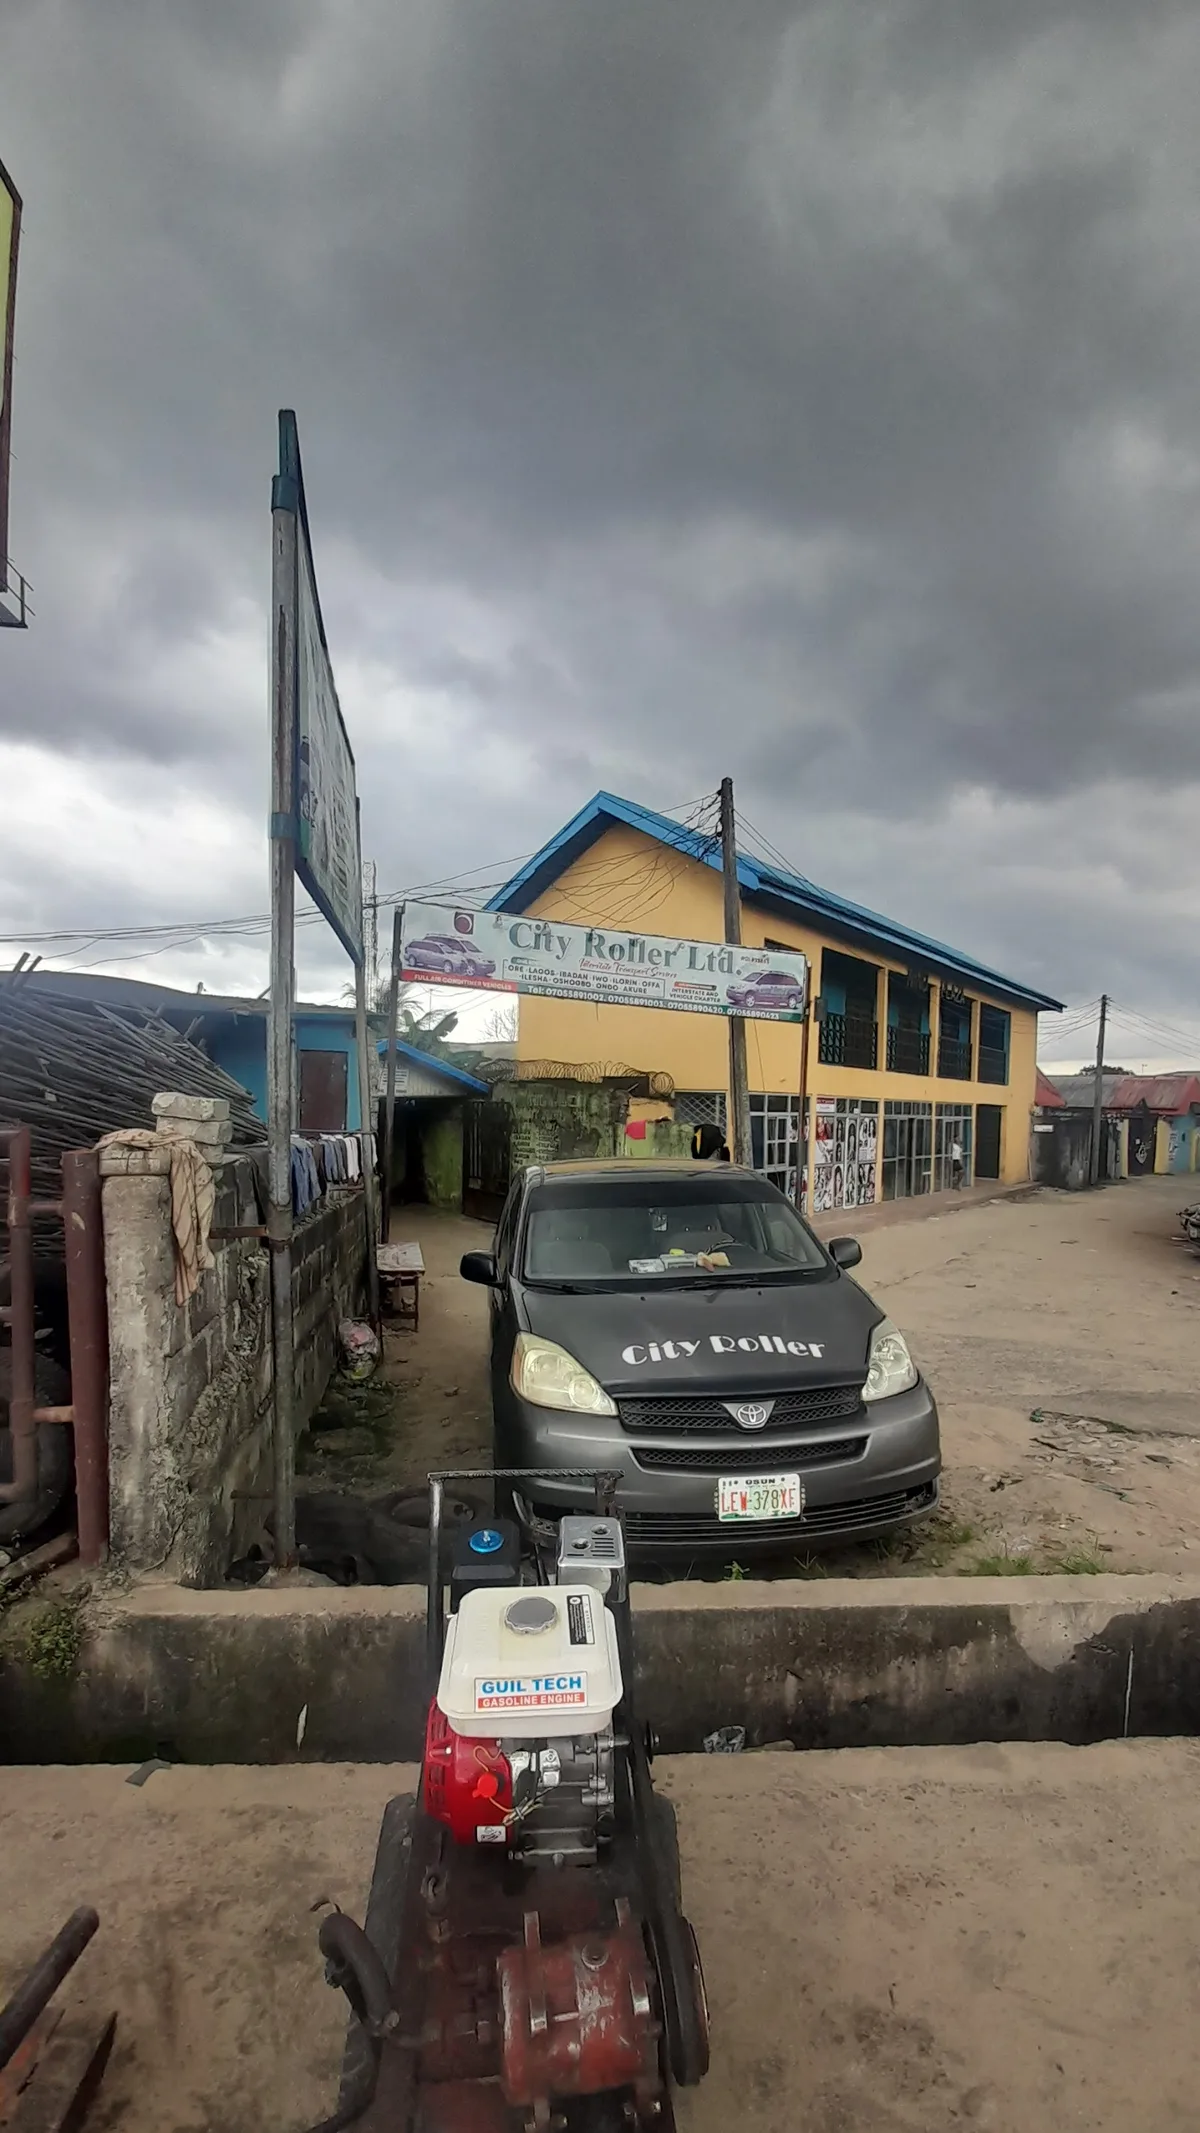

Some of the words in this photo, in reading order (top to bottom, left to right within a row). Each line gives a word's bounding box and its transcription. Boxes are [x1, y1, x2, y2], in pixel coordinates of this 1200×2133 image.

[508, 922, 572, 960] City
[584, 931, 678, 967] Roller
[508, 964, 523, 973] ORE
[559, 971, 588, 980] IBADAN
[593, 976, 609, 984] IWO
[613, 978, 637, 986] ILORIN
[642, 981, 660, 989] OFFA
[521, 974, 548, 983] ILESHA
[596, 983, 619, 991] ONDO
[623, 986, 648, 995] AKURE
[621, 1339, 701, 1365] City
[709, 1335, 825, 1358] Roller
[482, 1680, 528, 1694] GUIL
[531, 1676, 582, 1691] TECH
[482, 1696, 538, 1708] GASOLINE
[540, 1693, 581, 1705] ENGINE
